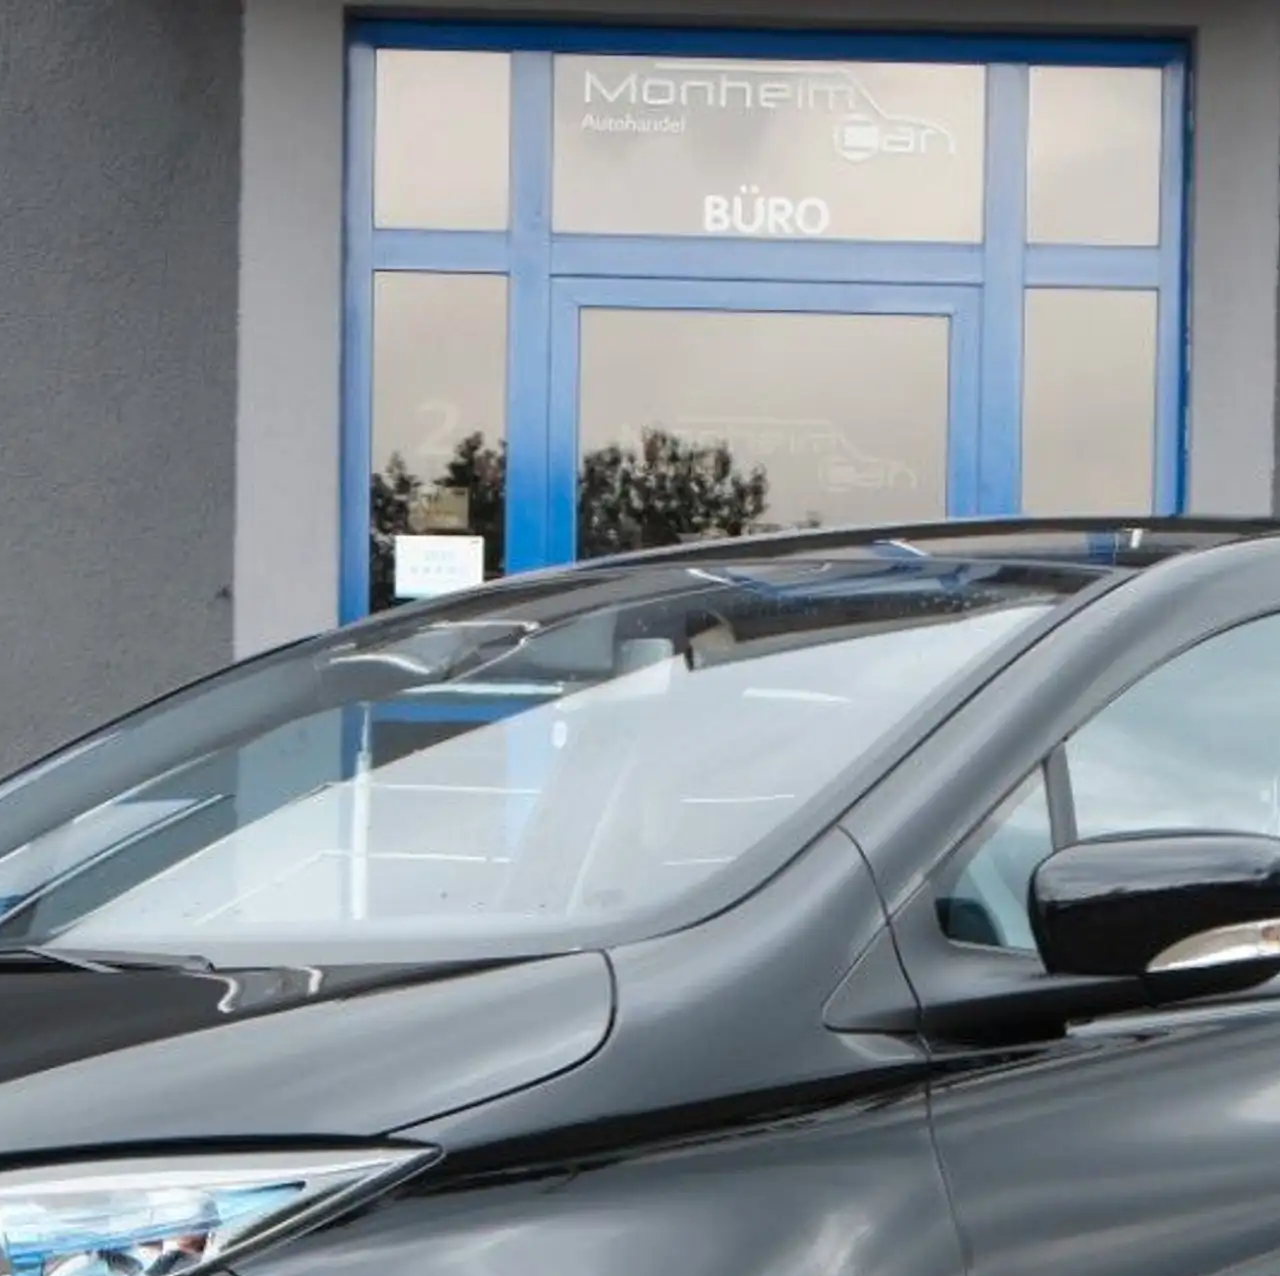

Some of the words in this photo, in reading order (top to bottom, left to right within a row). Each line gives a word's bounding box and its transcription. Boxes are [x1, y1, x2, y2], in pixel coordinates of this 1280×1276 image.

[584, 70, 857, 110] Monheim
[581, 111, 687, 135] Autohandel
[702, 184, 831, 235] BÜRO
